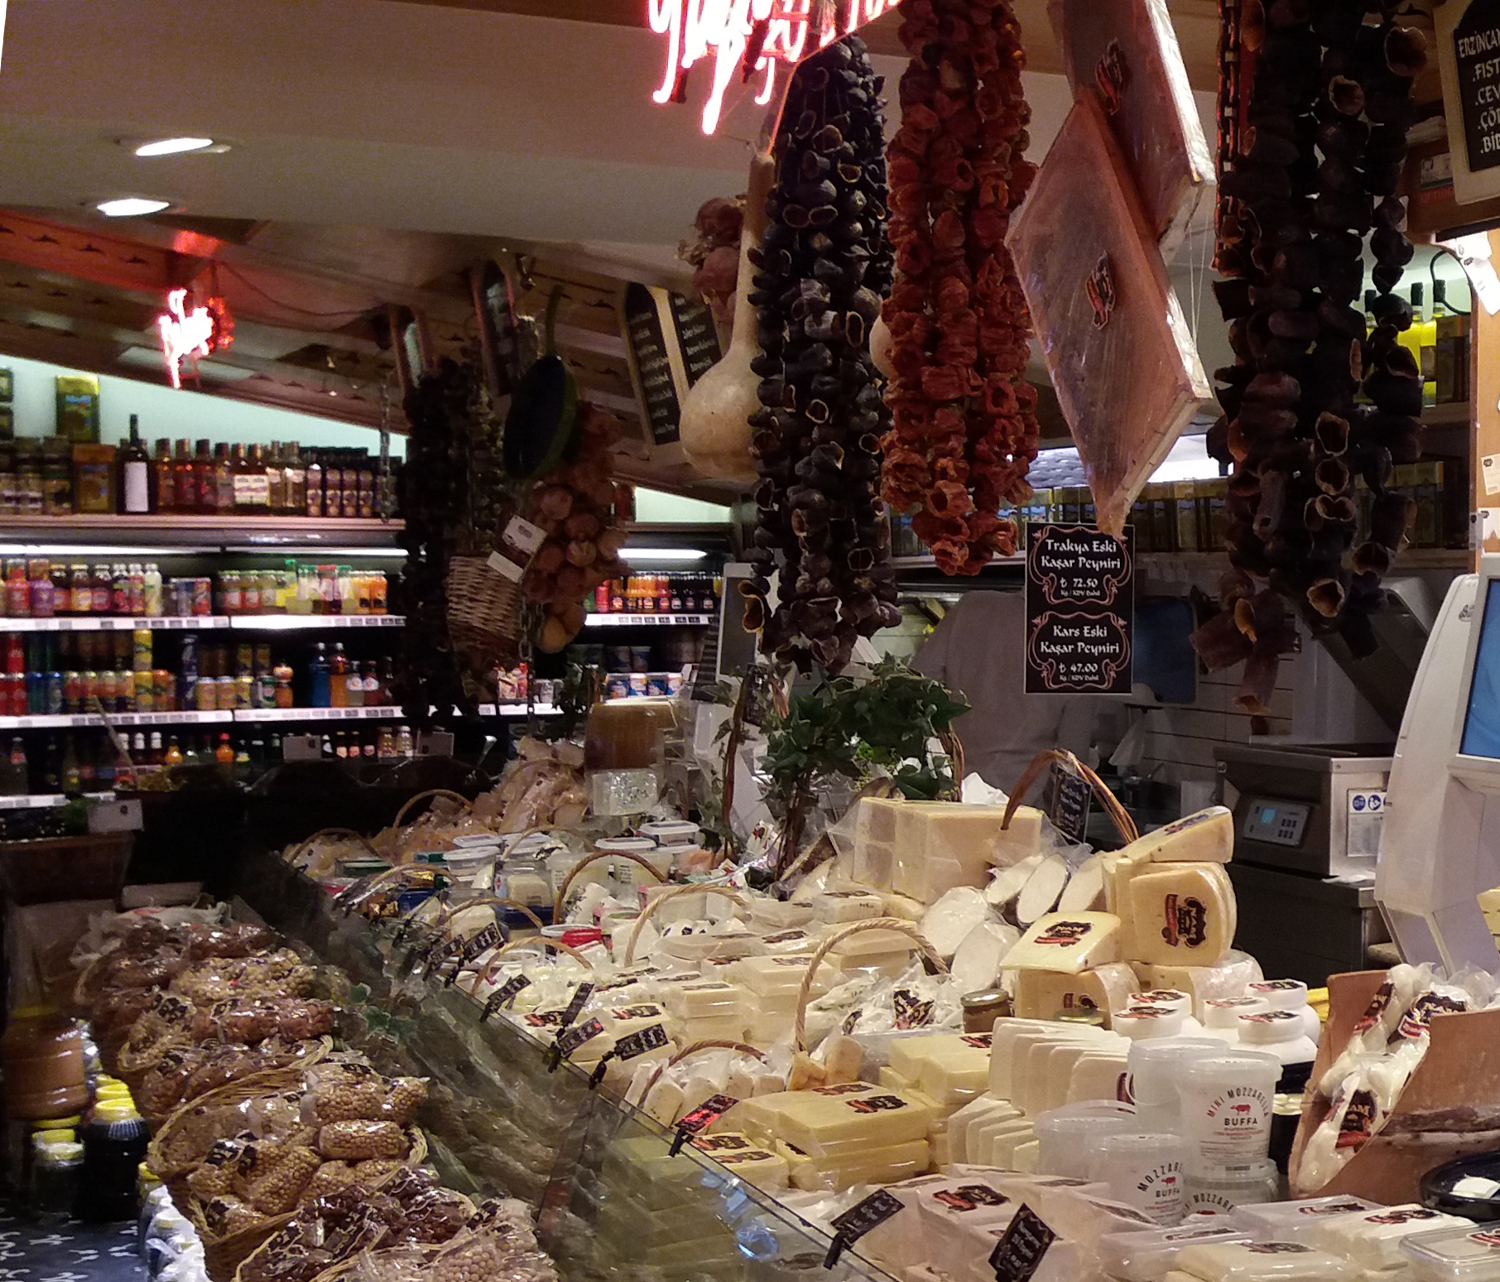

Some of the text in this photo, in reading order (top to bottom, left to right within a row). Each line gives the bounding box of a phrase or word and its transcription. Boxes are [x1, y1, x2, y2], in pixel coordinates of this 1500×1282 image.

[1045, 538, 1117, 554] Trakya Eski
[1041, 555, 1121, 571] Kaşar Peyniri
[1072, 578, 1098, 588] 72.50
[1053, 625, 1108, 638] Kars Eski
[1040, 641, 1120, 656] Kaşar Peyniri
[1070, 662, 1098, 673] 47.00
[1188, 904, 1200, 941] NAM
[1207, 1086, 1269, 1118] MINI MOZZARELLA
[1224, 1117, 1258, 1126] BUFFA
